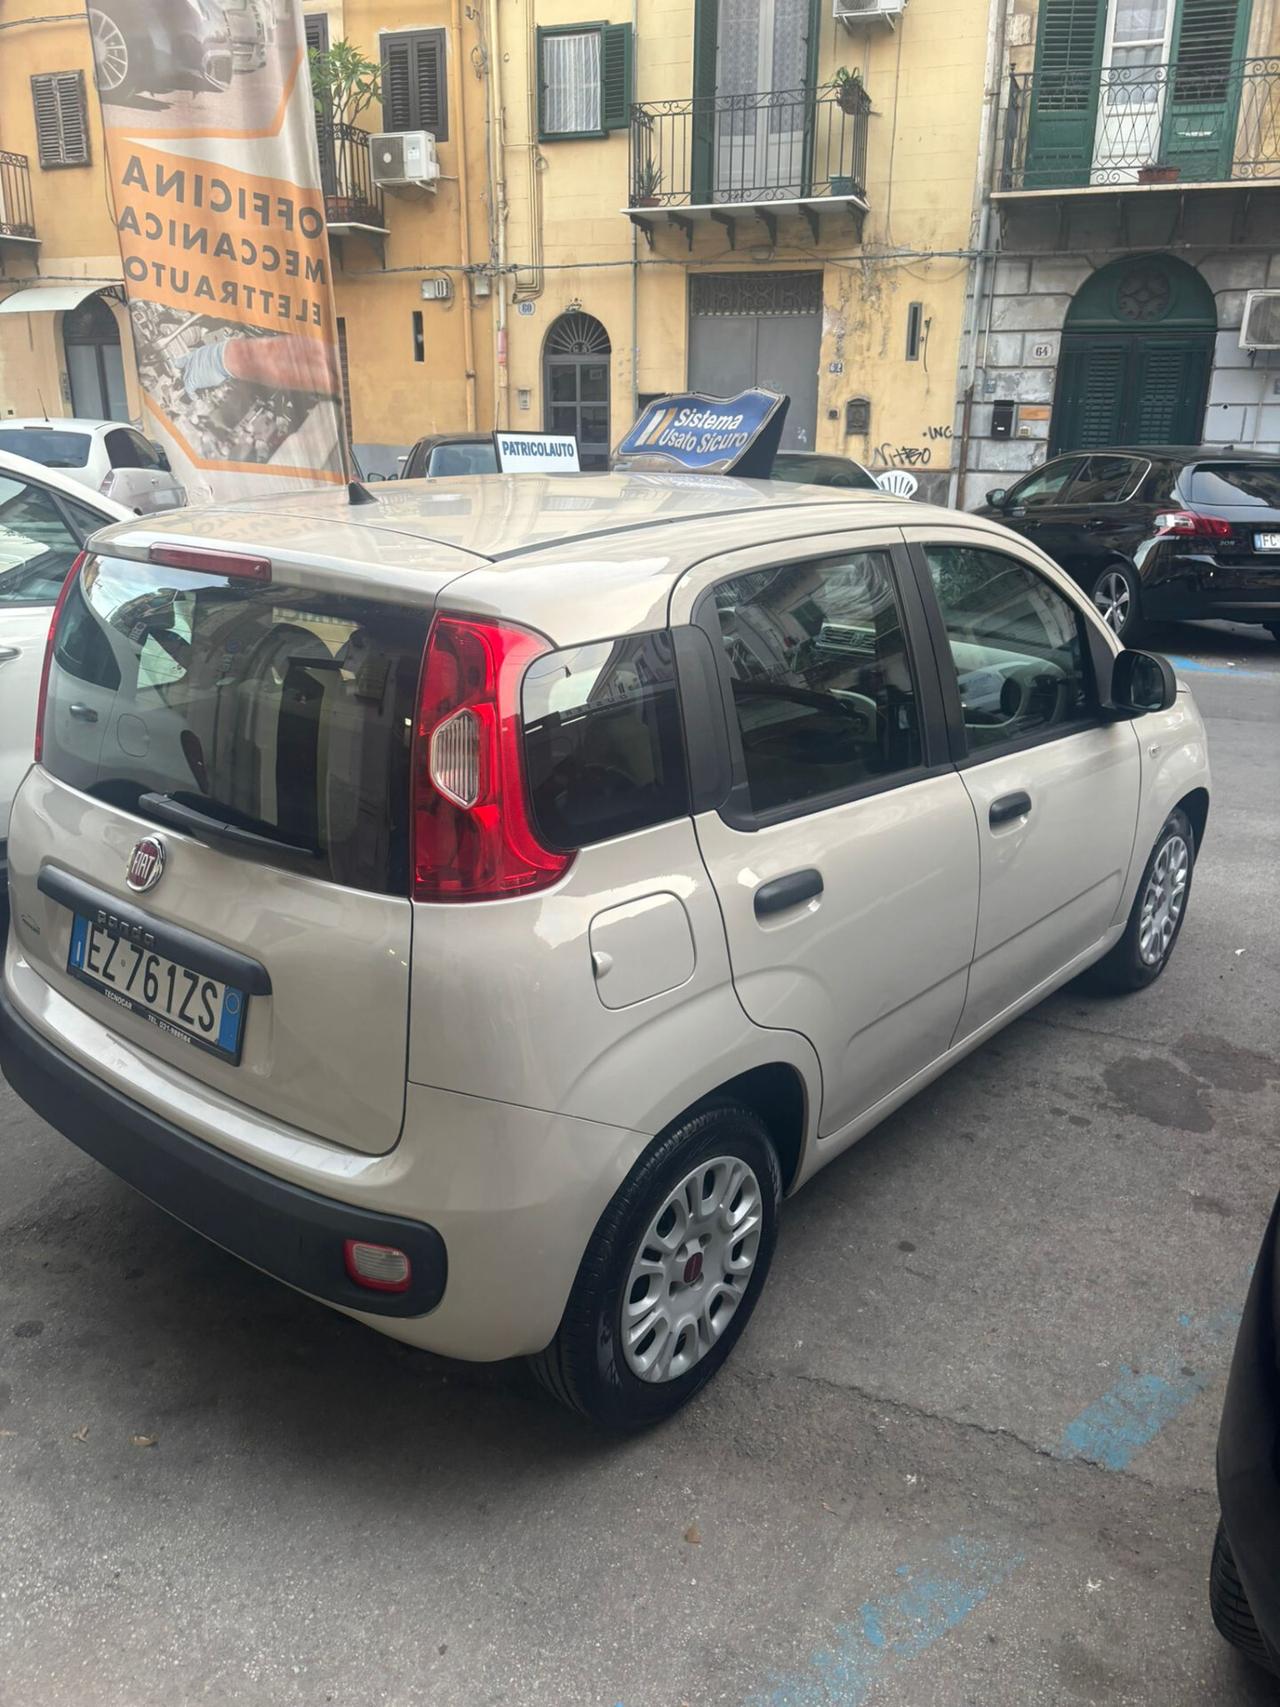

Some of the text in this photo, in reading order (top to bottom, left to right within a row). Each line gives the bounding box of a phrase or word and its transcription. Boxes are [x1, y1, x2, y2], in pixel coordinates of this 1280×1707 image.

[1035, 346, 1049, 357] 64
[674, 408, 744, 431] Sistema
[502, 441, 575, 458] PATRICOLAUTO
[658, 428, 749, 454] Usato Sicuro
[131, 850, 155, 880] FIAT
[104, 988, 133, 1011] TECNOCAR
